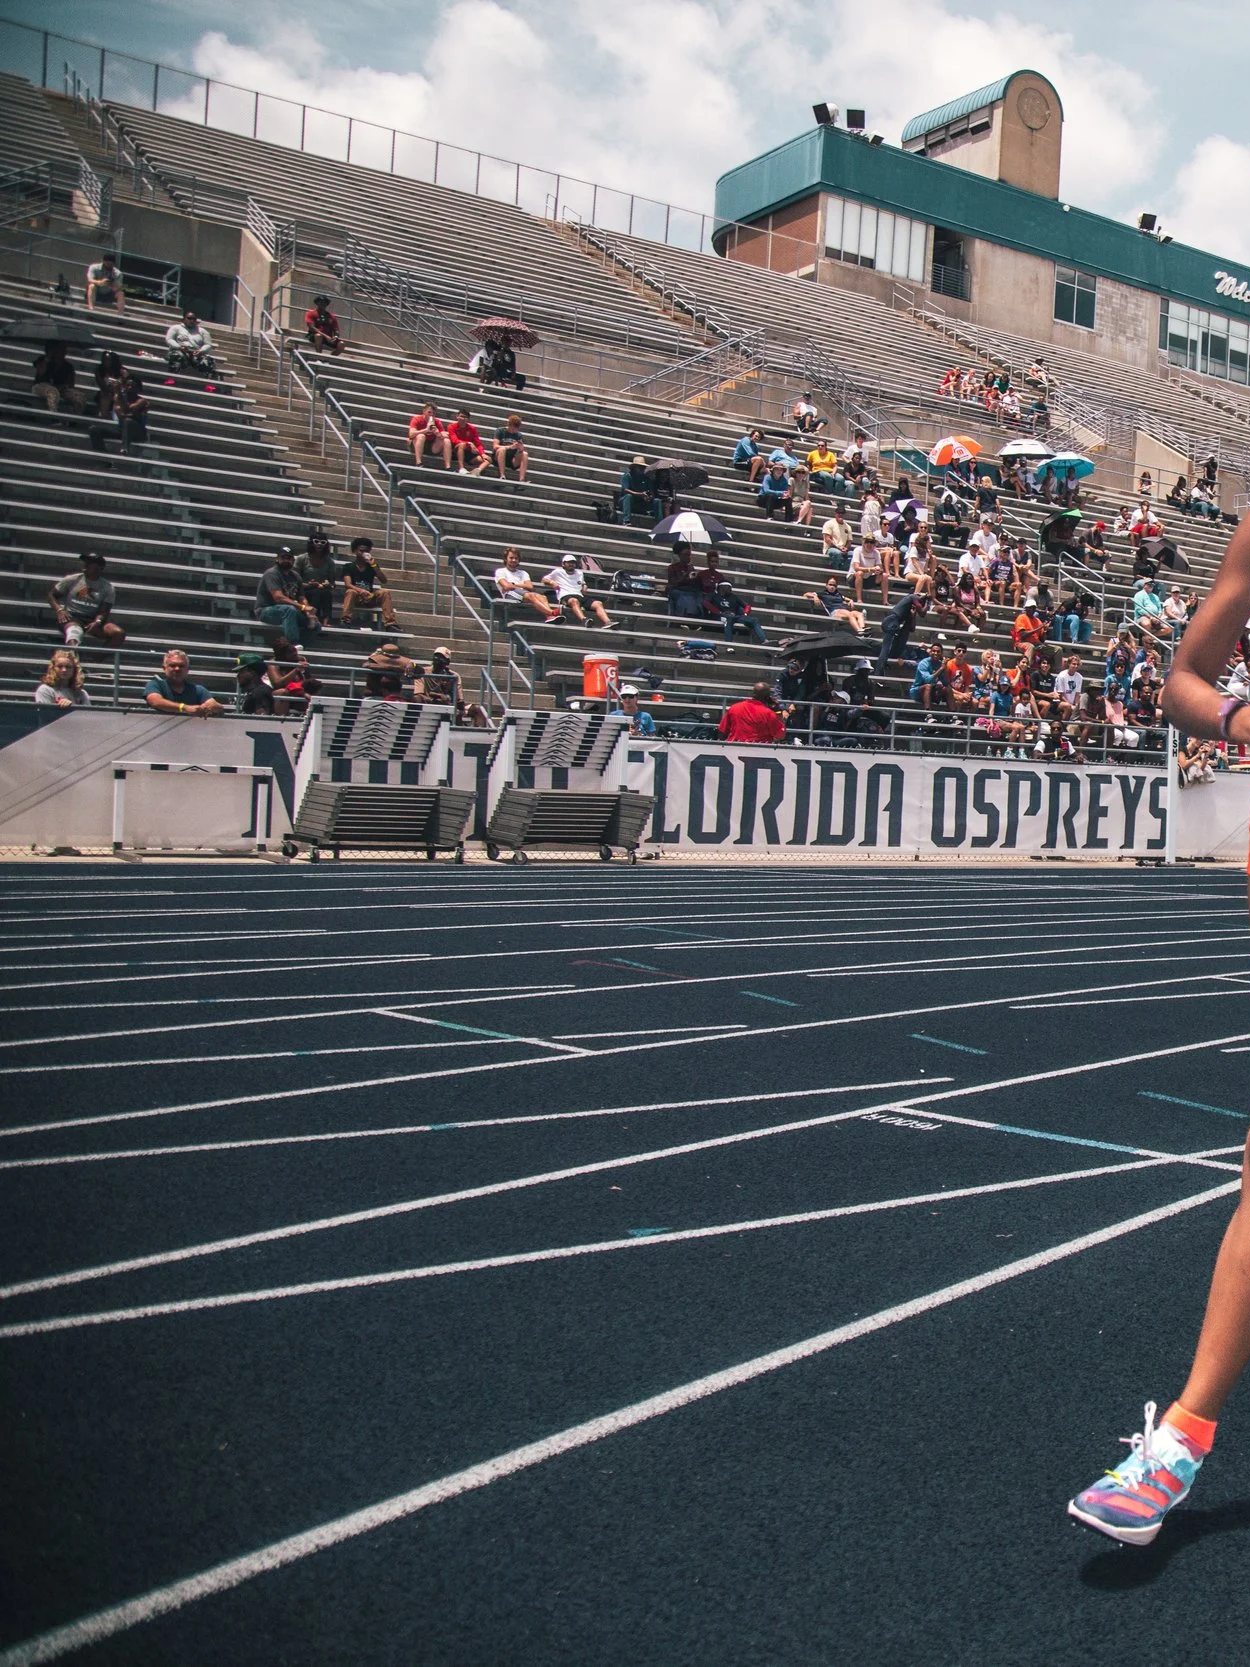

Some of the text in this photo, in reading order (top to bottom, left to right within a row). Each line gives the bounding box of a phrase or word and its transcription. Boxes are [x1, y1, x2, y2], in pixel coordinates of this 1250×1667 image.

[607, 665, 616, 678] G
[627, 750, 905, 848] LORIDA
[931, 766, 1168, 850] OSPREYS
